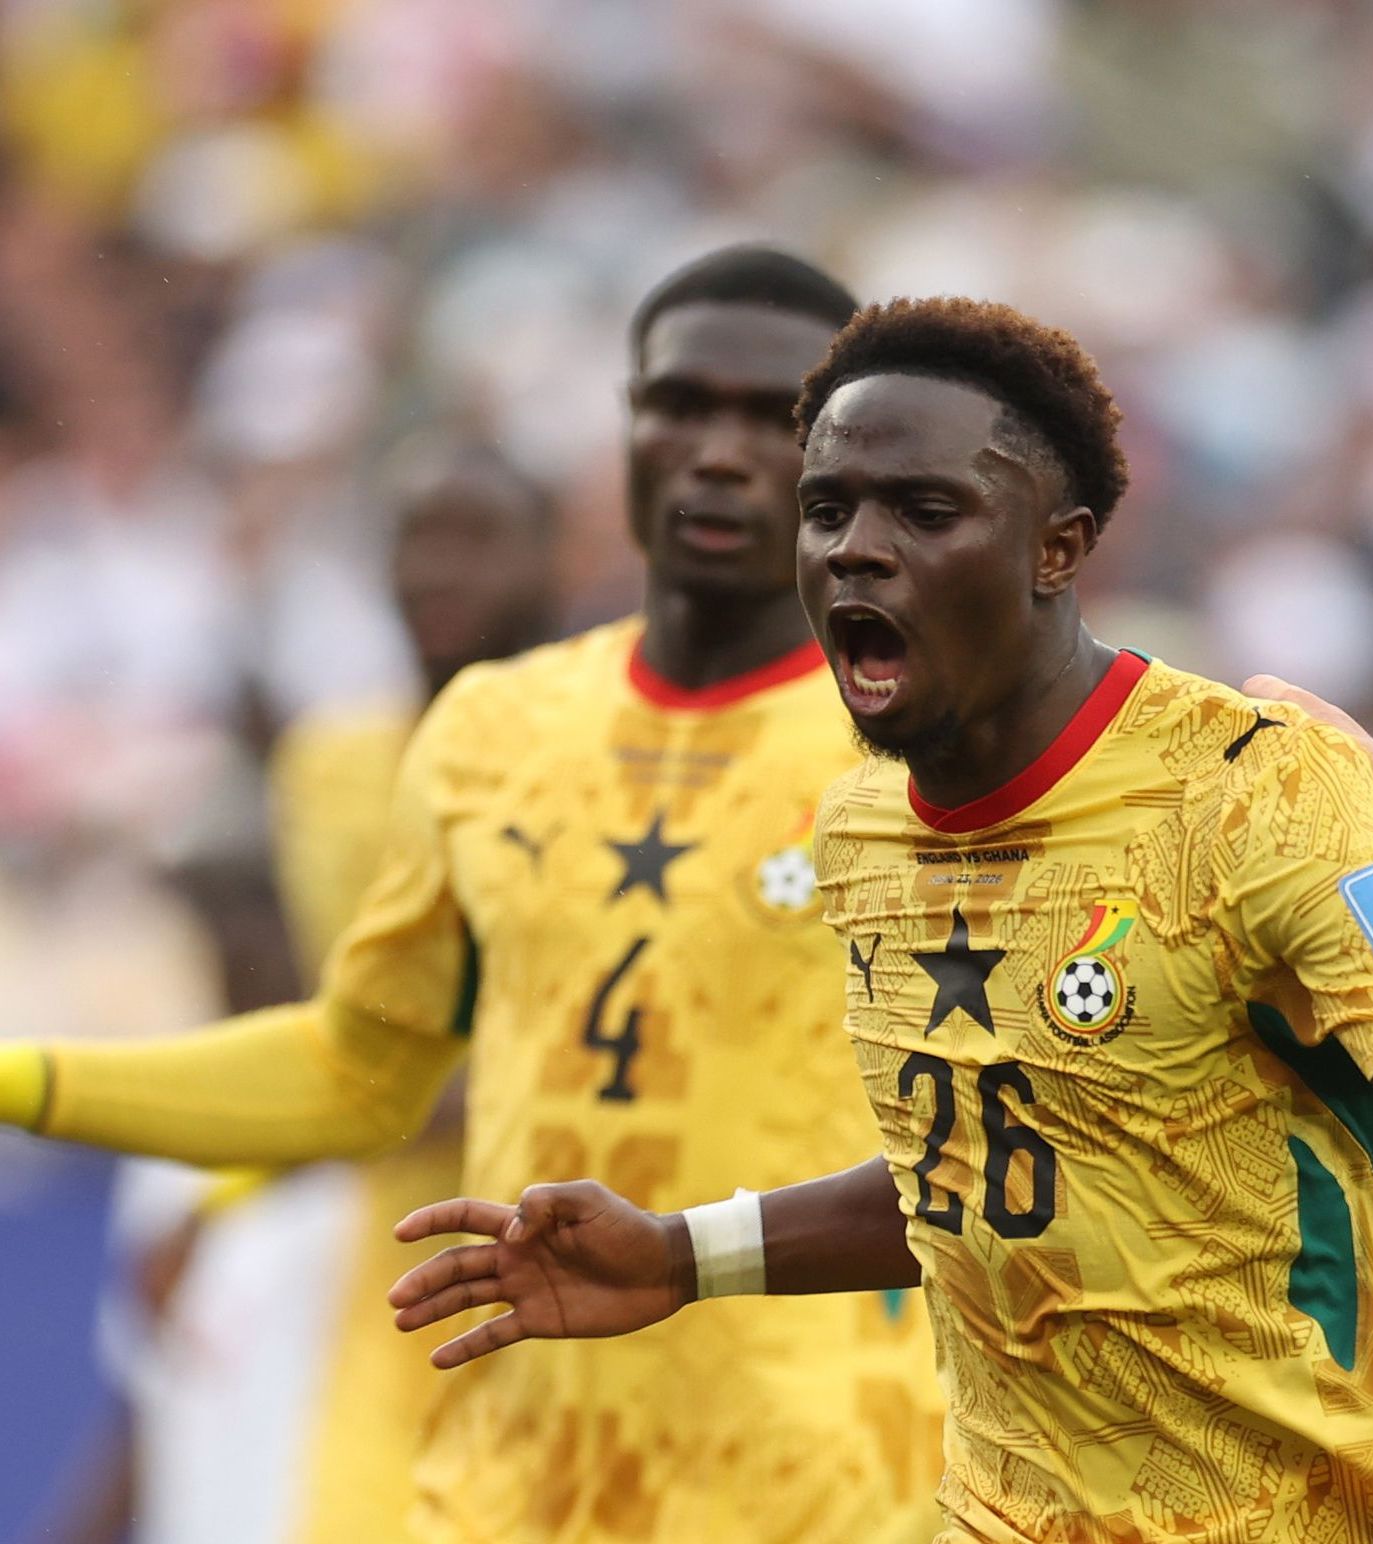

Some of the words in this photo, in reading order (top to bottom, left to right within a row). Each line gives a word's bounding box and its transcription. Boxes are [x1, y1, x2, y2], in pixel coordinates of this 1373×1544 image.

[915, 851, 962, 865] ENGLAND
[963, 851, 981, 864] VS
[982, 848, 1030, 862] GHANA
[584, 935, 650, 1105] 4
[898, 1051, 1056, 1240] 26
